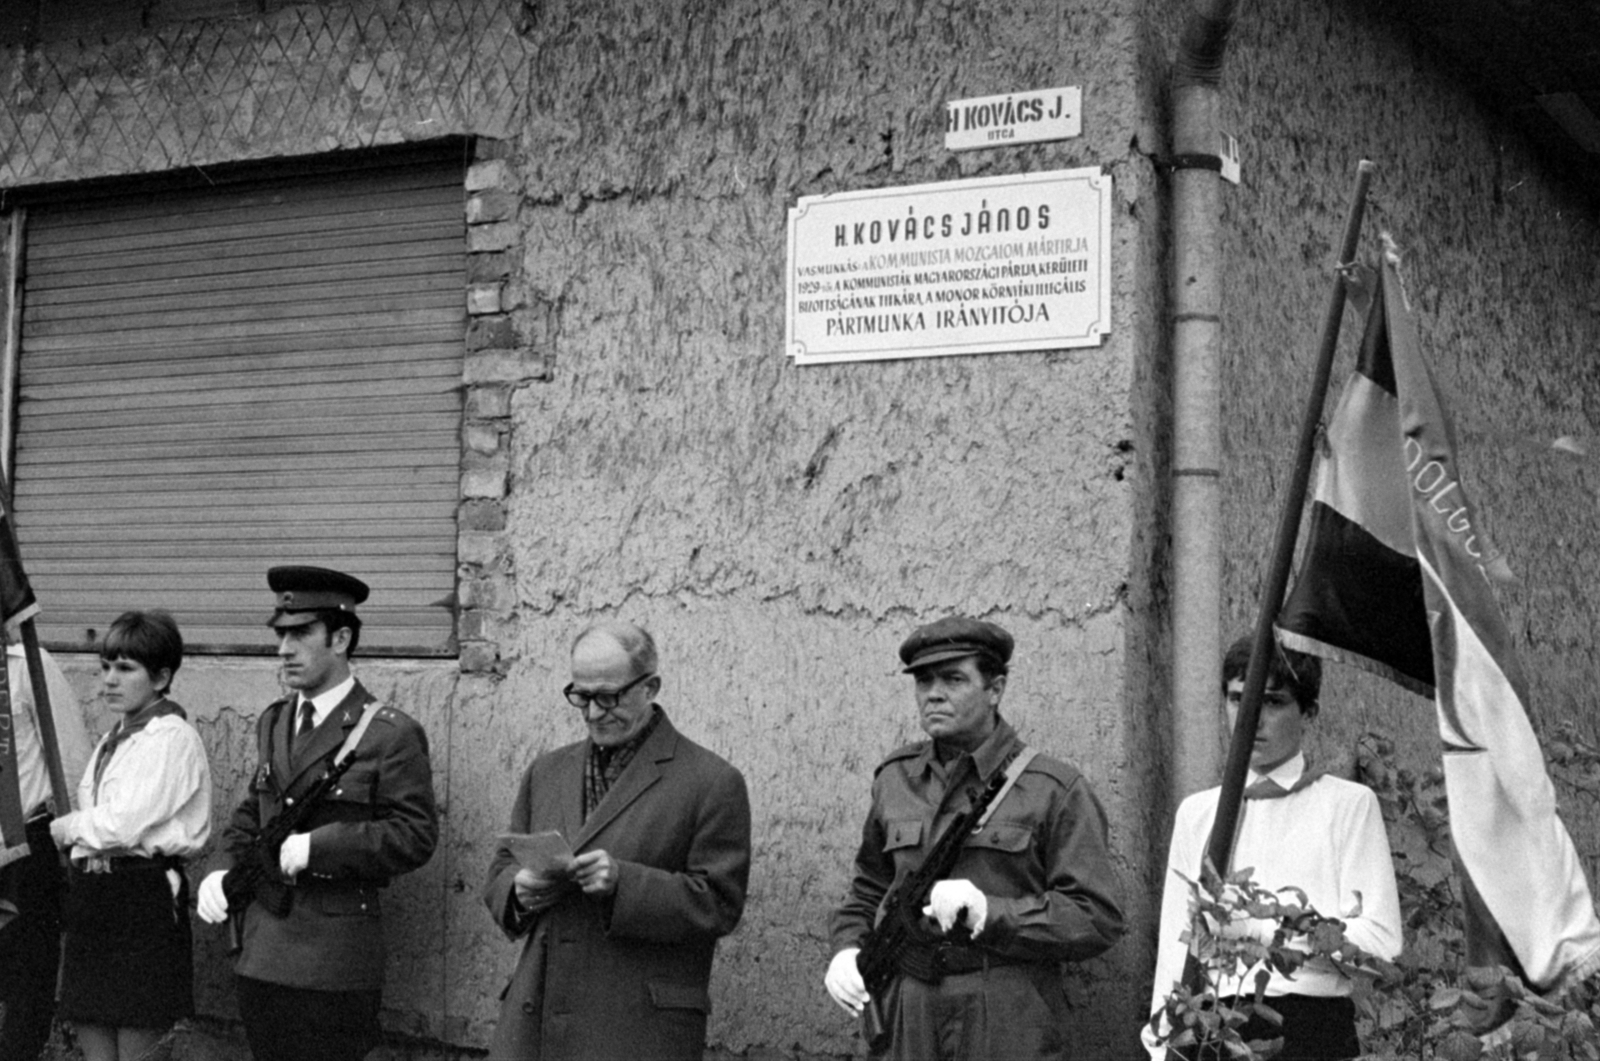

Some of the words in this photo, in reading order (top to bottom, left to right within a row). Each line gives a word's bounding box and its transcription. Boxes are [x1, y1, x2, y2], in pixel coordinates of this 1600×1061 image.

[964, 96, 1044, 130] KOVÁCS
[1048, 95, 1071, 119] J.
[987, 128, 1015, 140] UTCA
[960, 198, 1051, 236] JÁNOS
[869, 249, 951, 271] KOMMUNISTA
[953, 241, 1024, 263] MOZGALOM
[843, 269, 911, 291] KOMMUNISTÁK
[925, 290, 933, 304] A
[935, 287, 980, 303] MONOR
[826, 310, 926, 337] PÁRTMUNKA
